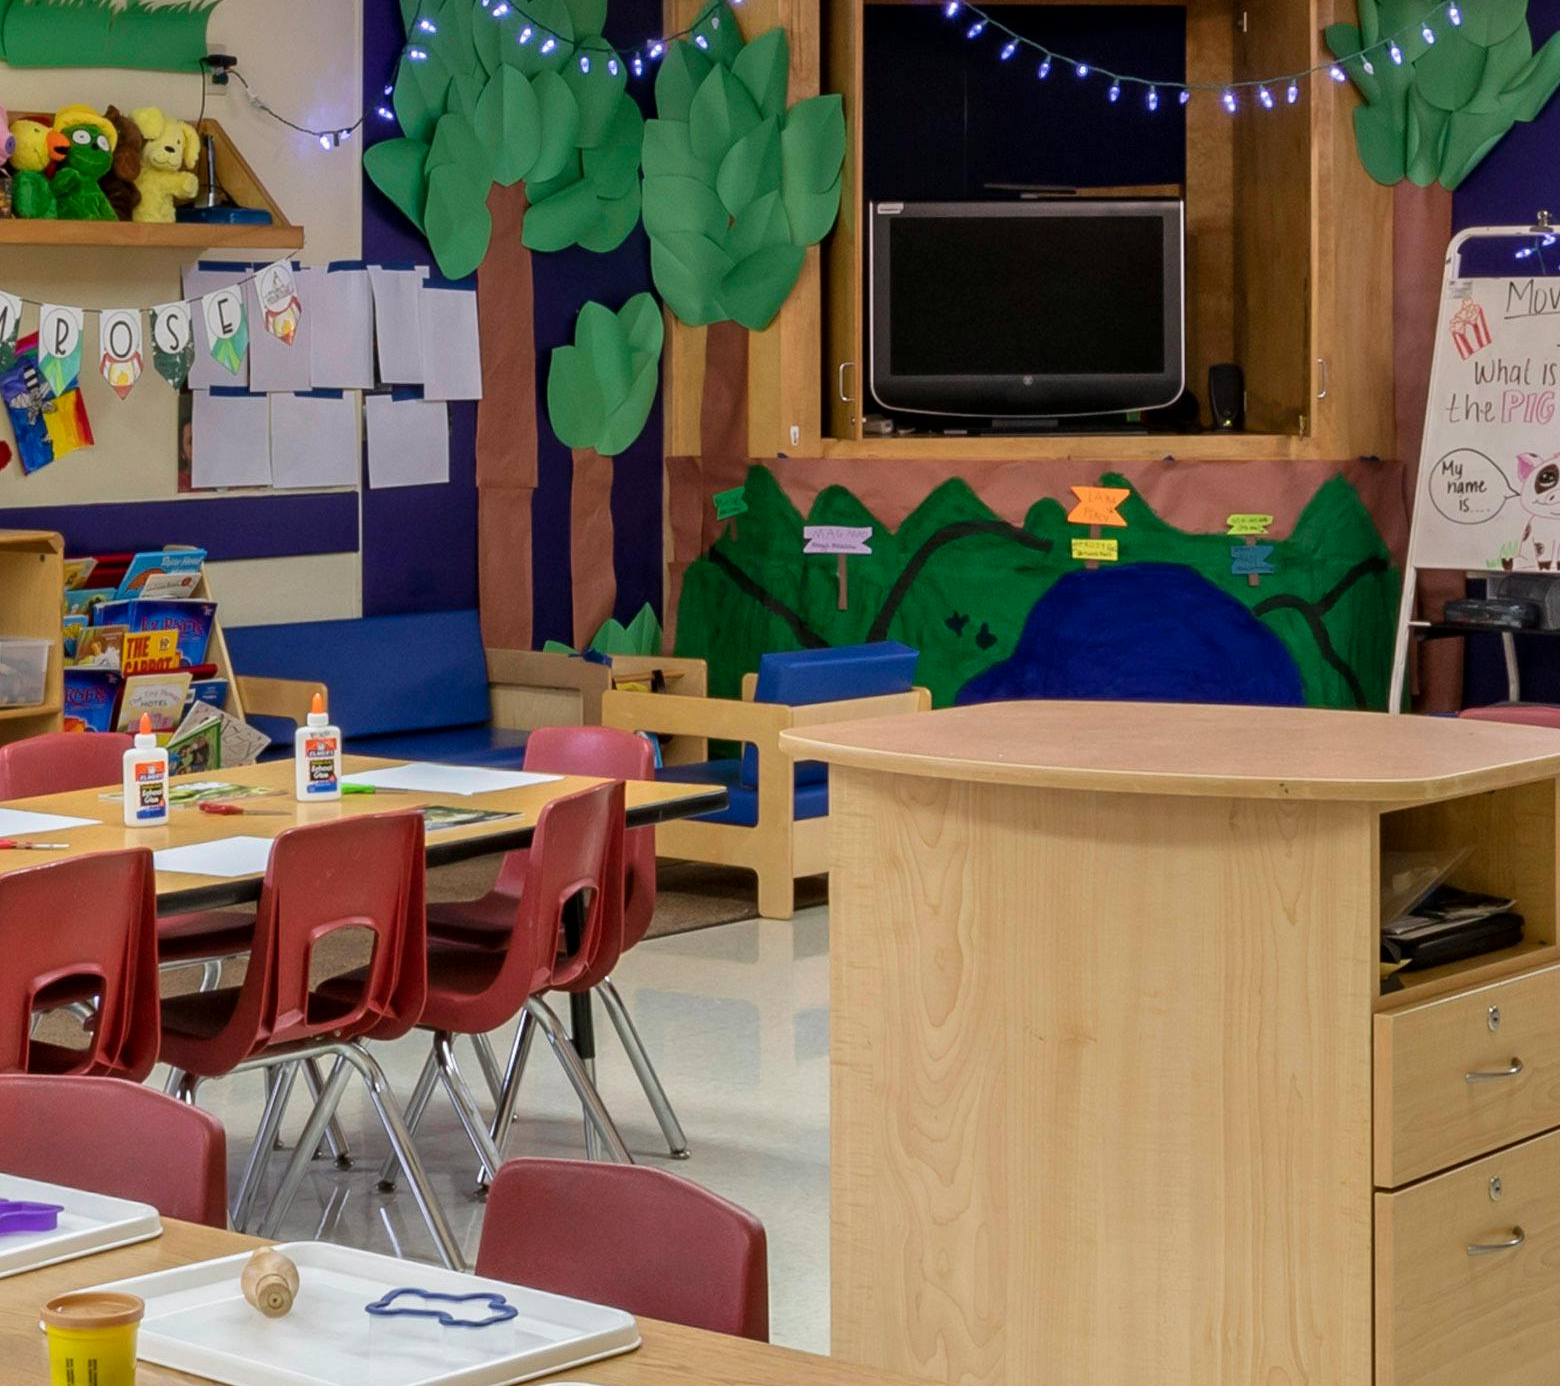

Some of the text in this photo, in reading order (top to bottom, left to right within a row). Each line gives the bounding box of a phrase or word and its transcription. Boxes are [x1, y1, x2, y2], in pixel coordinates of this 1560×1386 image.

[1473, 356, 1531, 387] What
[1540, 362, 1558, 386] is
[1446, 394, 1495, 424] the
[1499, 389, 1557, 425] PIG
[1441, 460, 1463, 480] My
[1447, 480, 1488, 494] name
[127, 636, 150, 659] THE
